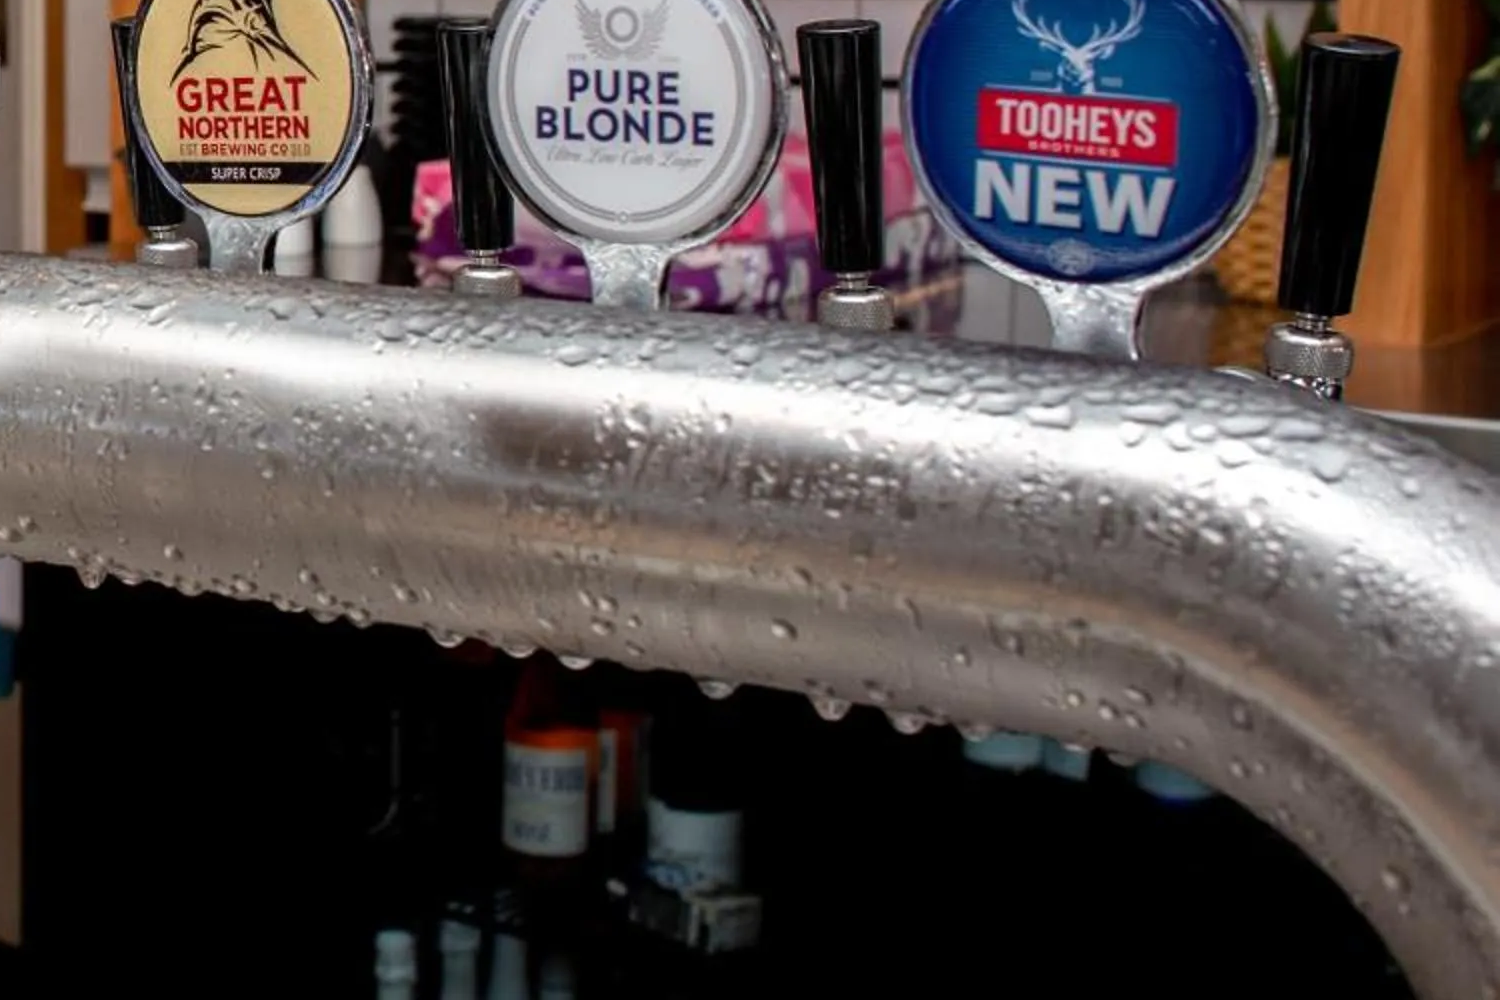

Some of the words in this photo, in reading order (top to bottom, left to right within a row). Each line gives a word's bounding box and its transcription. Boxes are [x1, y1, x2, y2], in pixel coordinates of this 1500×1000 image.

[176, 76, 307, 112] GREAT
[567, 69, 680, 105] PURE
[178, 116, 310, 140] NORTHERN
[536, 106, 714, 146] BLONDE
[995, 98, 1156, 148] TOOHEYS
[201, 143, 267, 156] BREWING
[1028, 140, 1120, 158] BROTHERS
[211, 167, 247, 180] SUPER
[249, 167, 282, 180] CRISP
[974, 158, 1176, 238] NEW
